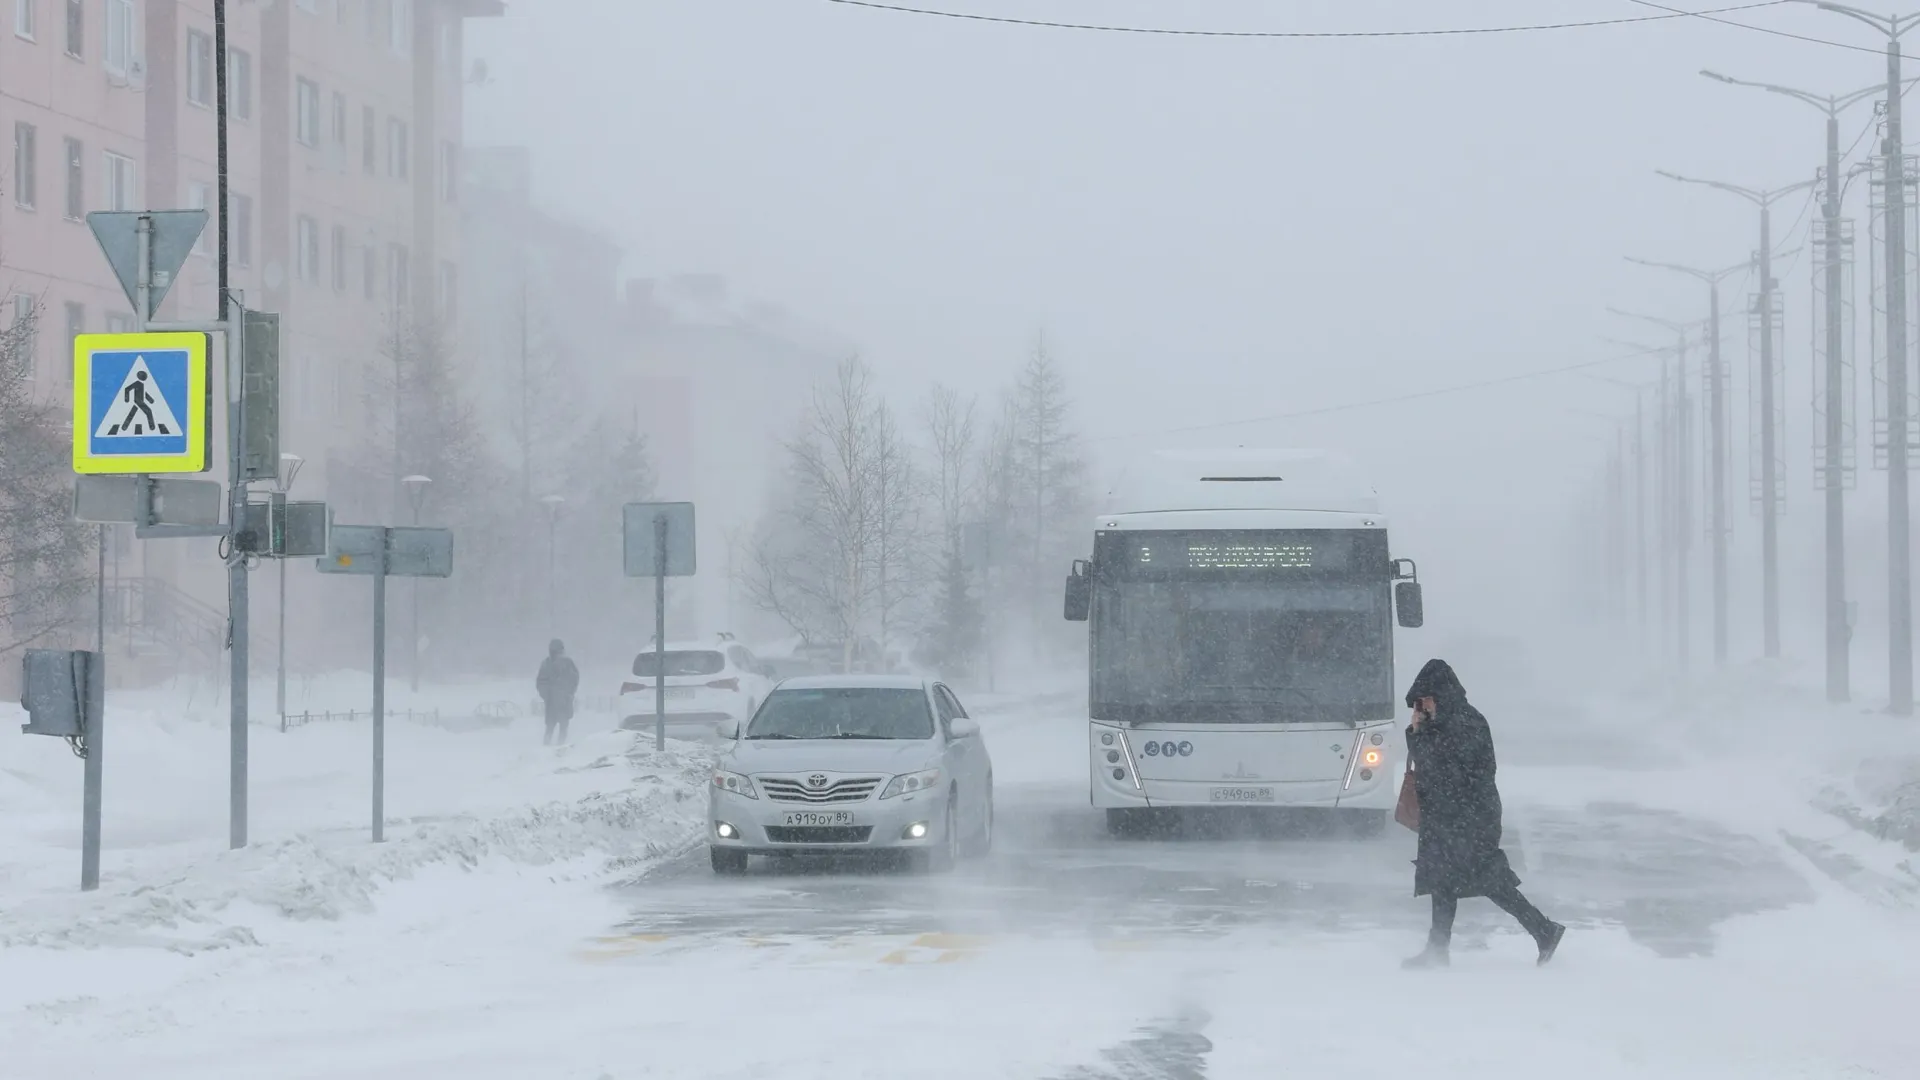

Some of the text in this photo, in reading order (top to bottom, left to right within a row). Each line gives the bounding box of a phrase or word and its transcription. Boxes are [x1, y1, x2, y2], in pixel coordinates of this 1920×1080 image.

[1141, 547, 1151, 562] 3
[786, 812, 848, 825] А919ОУ 89
